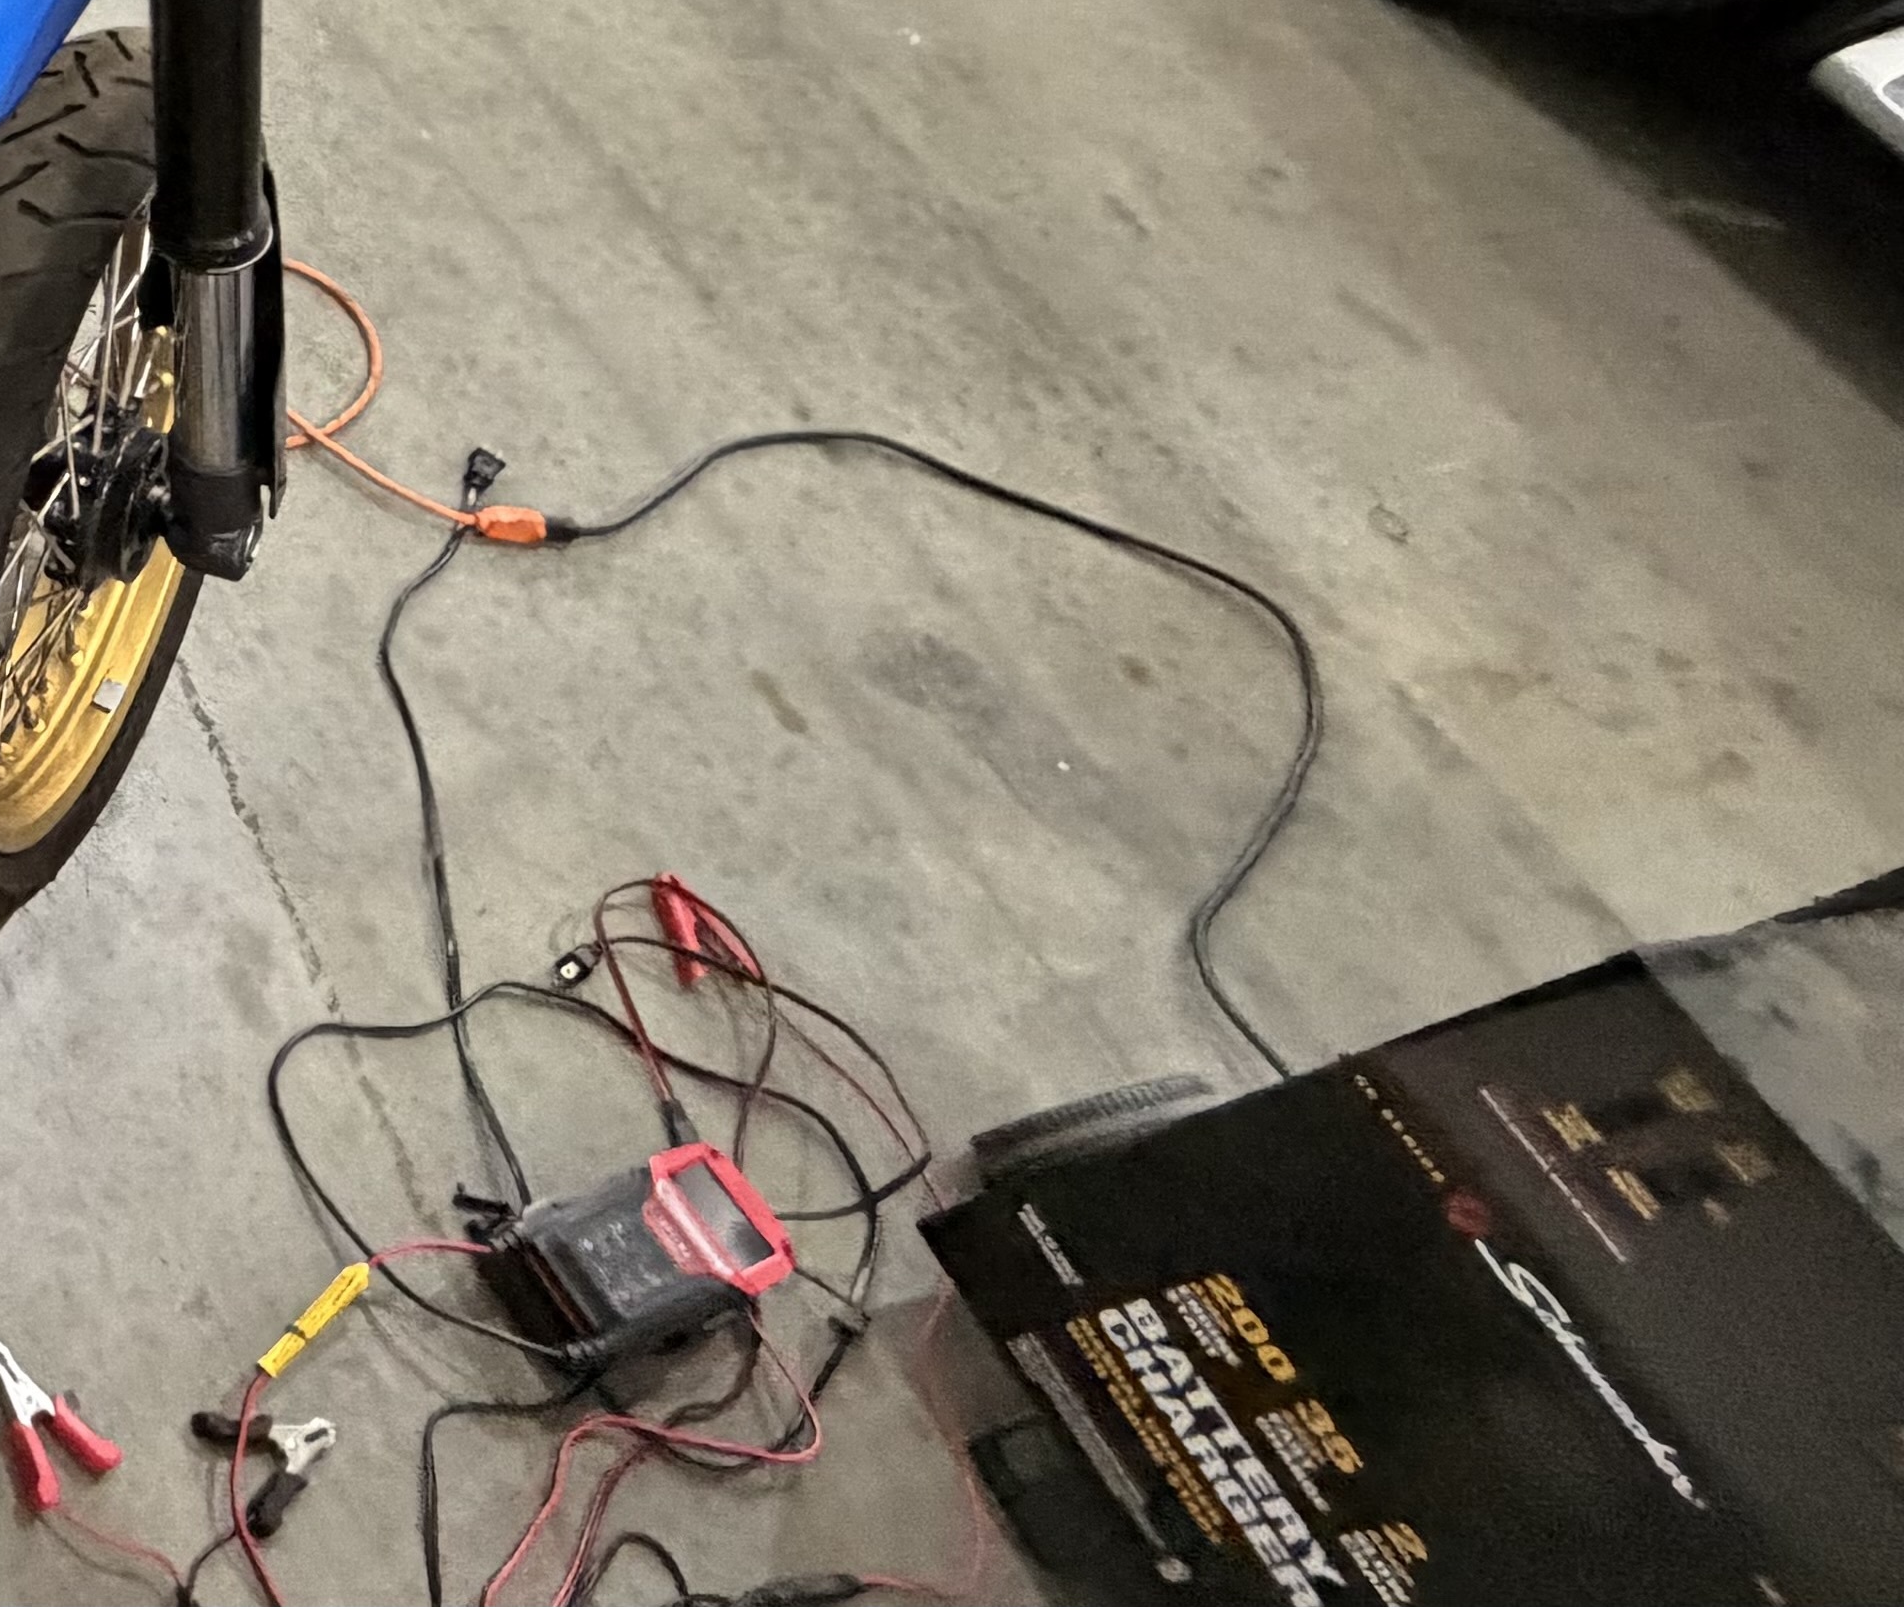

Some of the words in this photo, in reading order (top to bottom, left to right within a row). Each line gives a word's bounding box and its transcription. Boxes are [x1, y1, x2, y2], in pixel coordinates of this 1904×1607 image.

[1203, 1272, 1297, 1383] 200
[1098, 1307, 1325, 1607] CHARGER
[1122, 1297, 1348, 1587] BATTERY
[1294, 1398, 1364, 1474] 35
